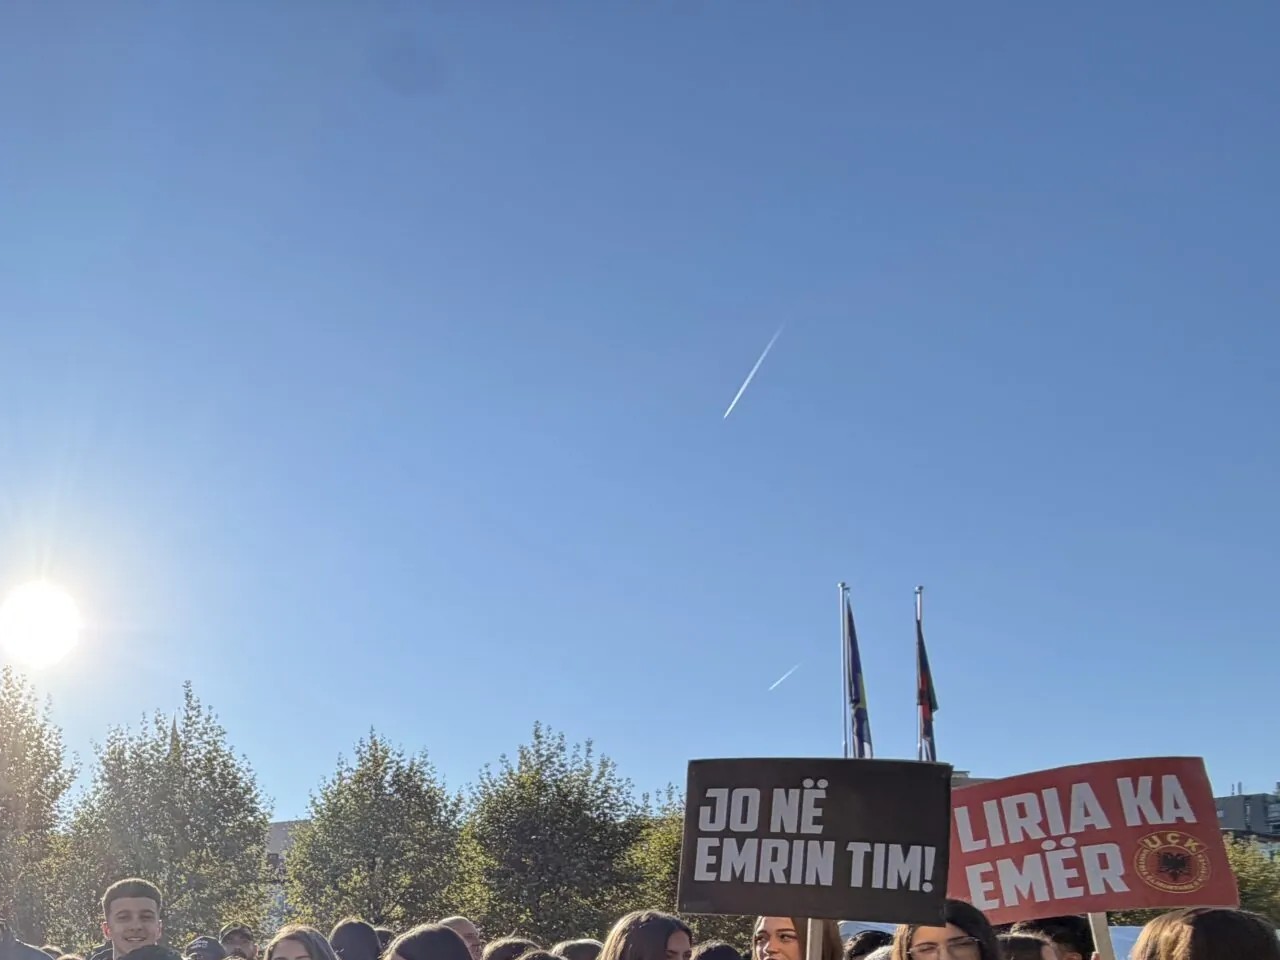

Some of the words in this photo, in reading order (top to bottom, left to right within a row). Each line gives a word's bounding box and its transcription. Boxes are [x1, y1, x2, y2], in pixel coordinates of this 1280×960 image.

[699, 788, 760, 832] JO
[770, 778, 829, 834] NË
[954, 782, 1111, 853] LIRIA
[1117, 774, 1198, 827] KA
[694, 837, 835, 887] EMRIN
[846, 841, 936, 893] TIM!
[965, 836, 1131, 912] EMËR
